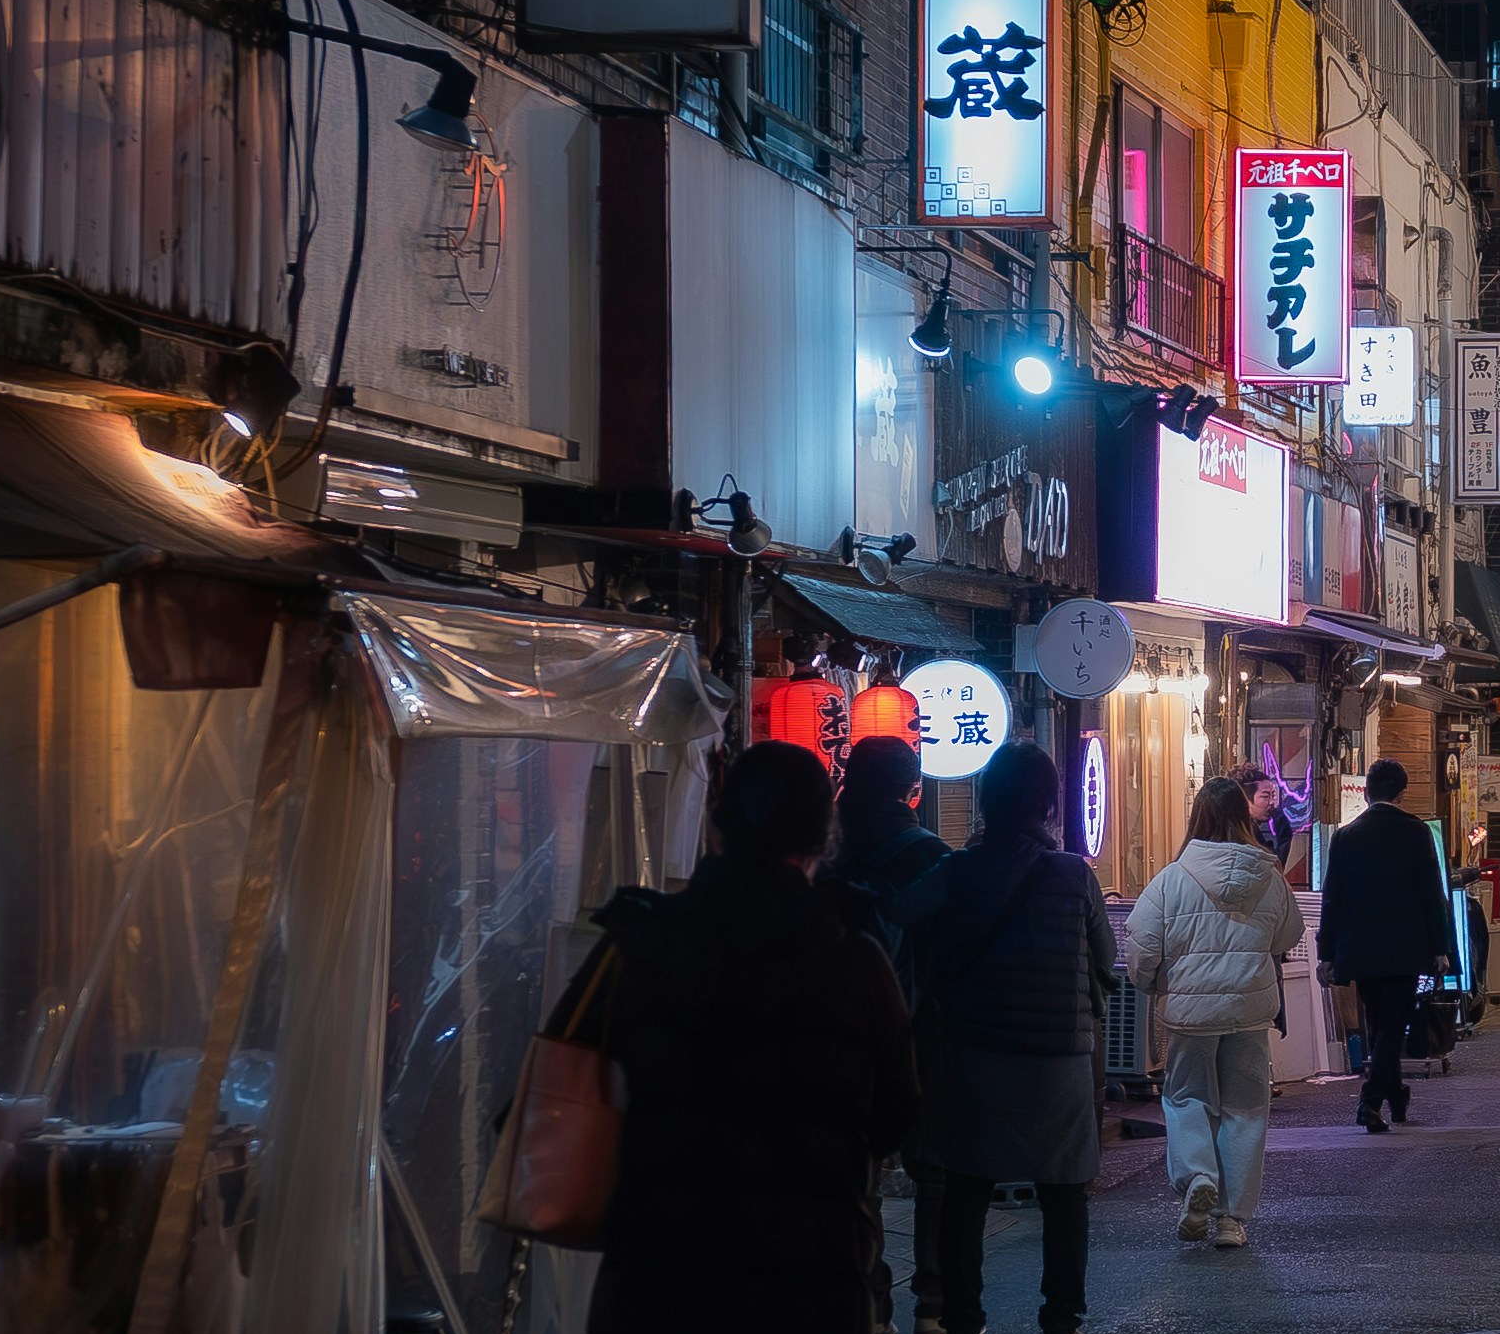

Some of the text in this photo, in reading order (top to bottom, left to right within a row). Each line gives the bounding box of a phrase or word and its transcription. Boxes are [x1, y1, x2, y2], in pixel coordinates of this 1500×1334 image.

[1248, 159, 1342, 187] 元祖千ベロ
[1265, 191, 1316, 371] サチアレ
[1360, 336, 1378, 408] すき田
[1468, 352, 1492, 380] 魚
[1468, 408, 1493, 435] 豊
[1070, 610, 1095, 687] 千いち
[921, 684, 974, 702] 二代目
